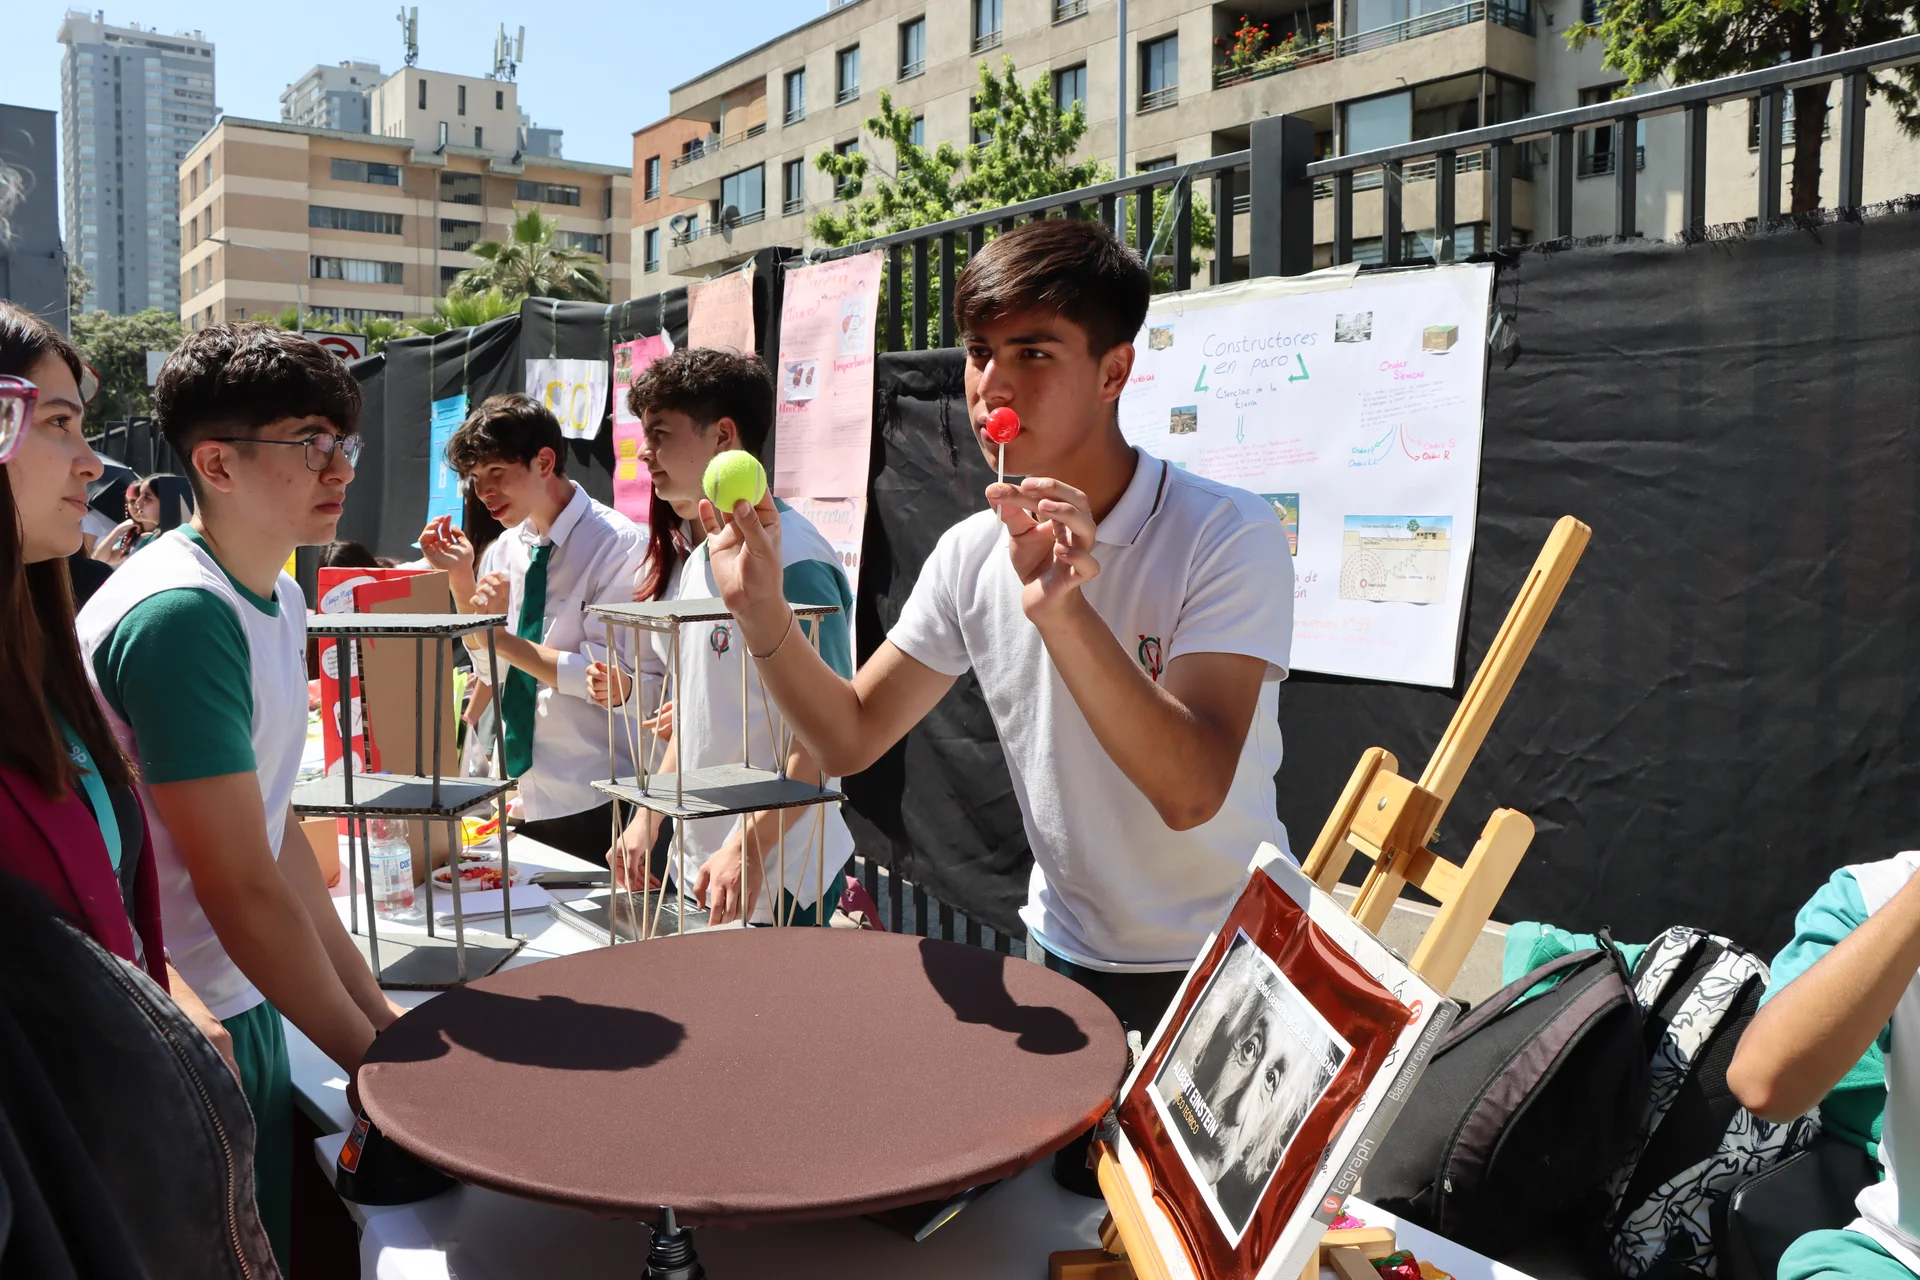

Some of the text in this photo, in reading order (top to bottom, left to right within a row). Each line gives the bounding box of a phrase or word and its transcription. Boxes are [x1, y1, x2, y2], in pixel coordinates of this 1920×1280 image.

[1203, 331, 1319, 358] Constructores
[1213, 355, 1289, 377] en paro
[1378, 357, 1409, 372] Ondas
[1215, 386, 1251, 399] Ciencias
[1443, 449, 1451, 460] R
[1304, 570, 1318, 583] de
[1267, 992, 1291, 1023] GENERAL
[1298, 1030, 1337, 1078] RELATIVIDAD
[1421, 1007, 1451, 1043] diseño
[1412, 1040, 1432, 1063] con
[1387, 1058, 1420, 1102] Bastidor
[1171, 1060, 1220, 1139] ALBERT EINSTEIN
[1182, 1103, 1200, 1136] TEÓRICO
[1330, 1137, 1375, 1195] tegraph
